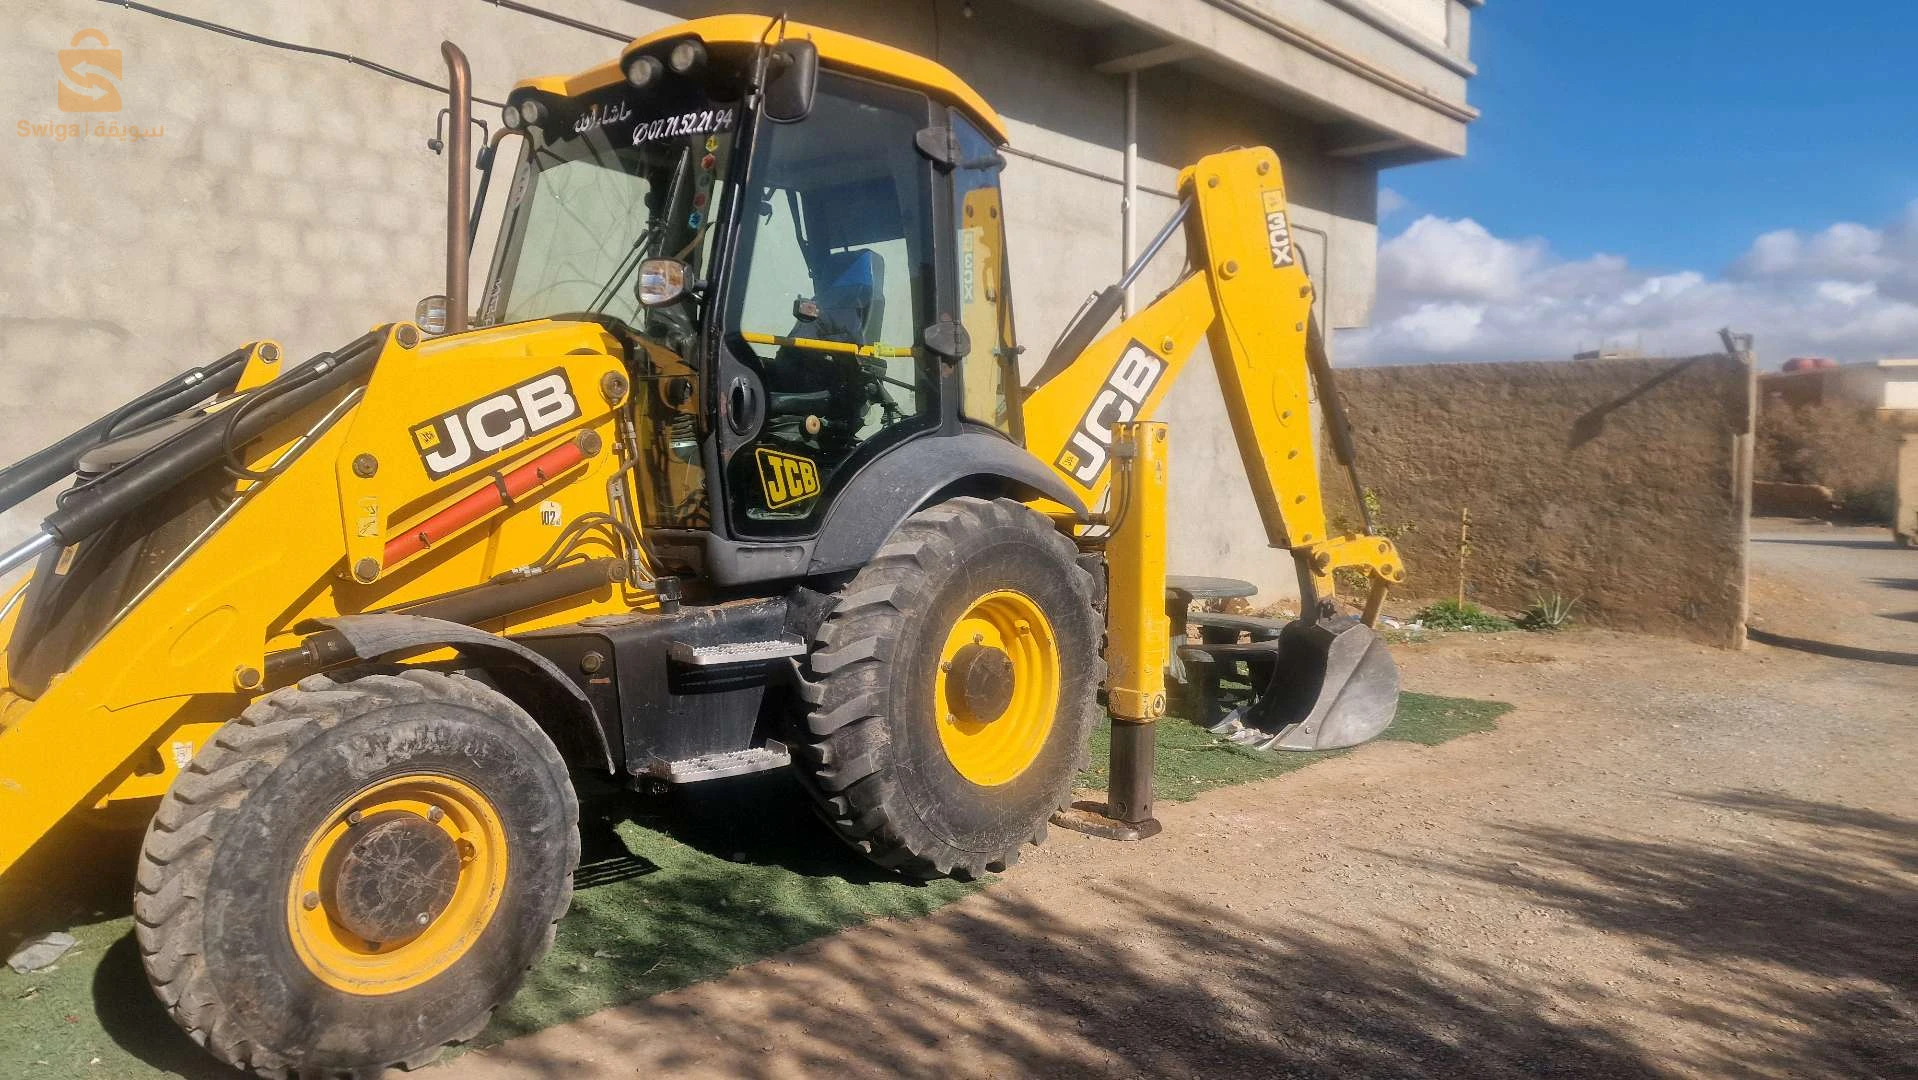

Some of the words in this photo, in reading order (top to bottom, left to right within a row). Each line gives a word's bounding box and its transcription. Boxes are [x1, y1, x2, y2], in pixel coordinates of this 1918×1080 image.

[647, 108, 733, 140] 07.71.52.21.94
[1267, 211, 1293, 265] 3CX
[425, 374, 576, 473] JCB
[1073, 346, 1161, 481] JCB
[767, 455, 817, 502] JCB
